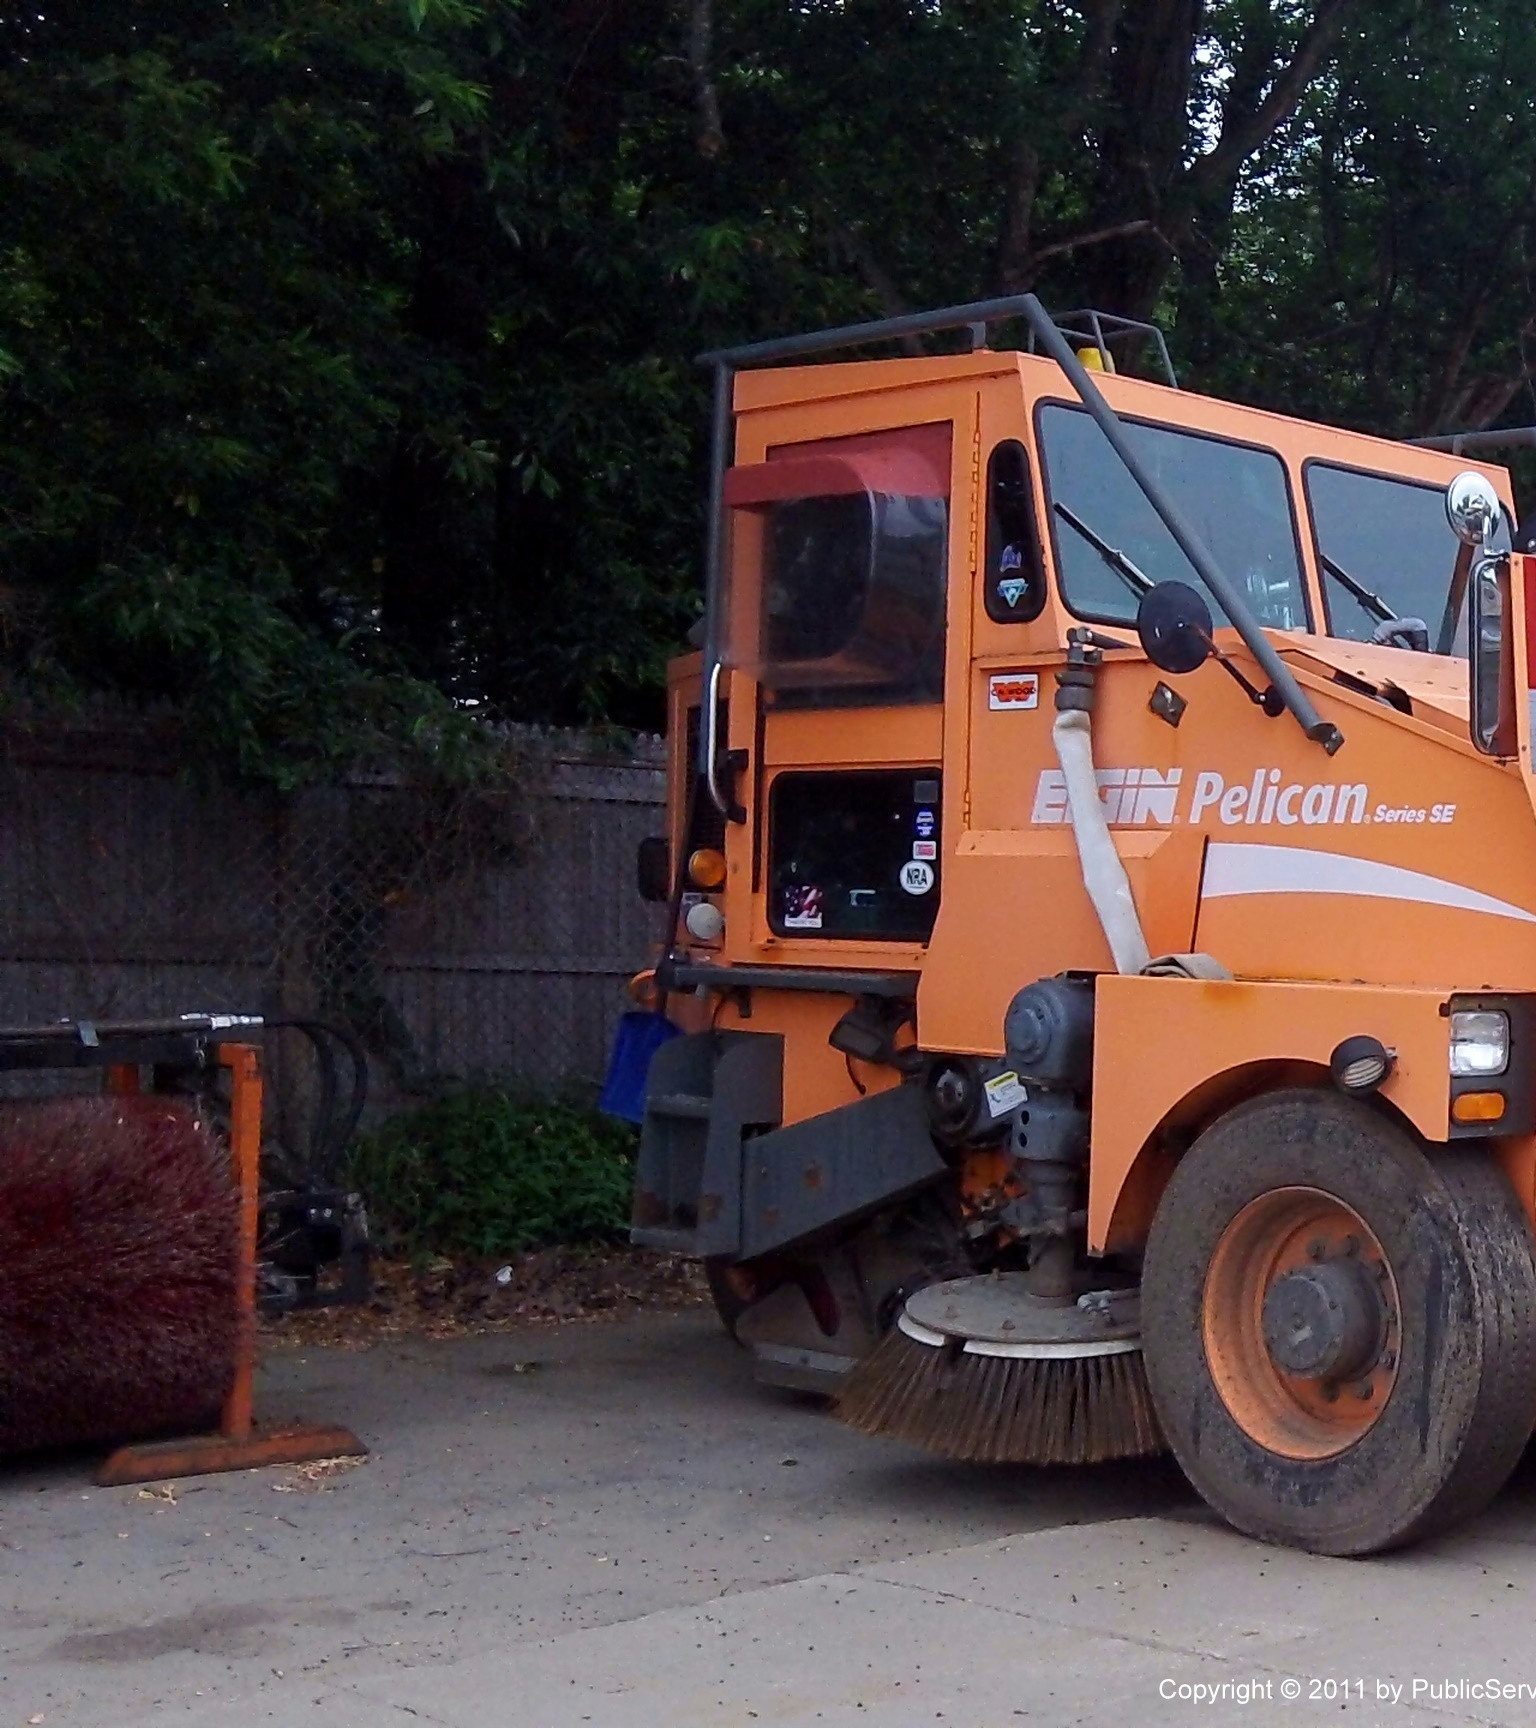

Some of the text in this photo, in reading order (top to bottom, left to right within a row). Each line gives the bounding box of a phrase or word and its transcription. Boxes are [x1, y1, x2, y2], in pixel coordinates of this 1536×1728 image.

[1030, 768, 1457, 825] EGIN Pelican Series SE
[906, 867, 928, 885] NRA
